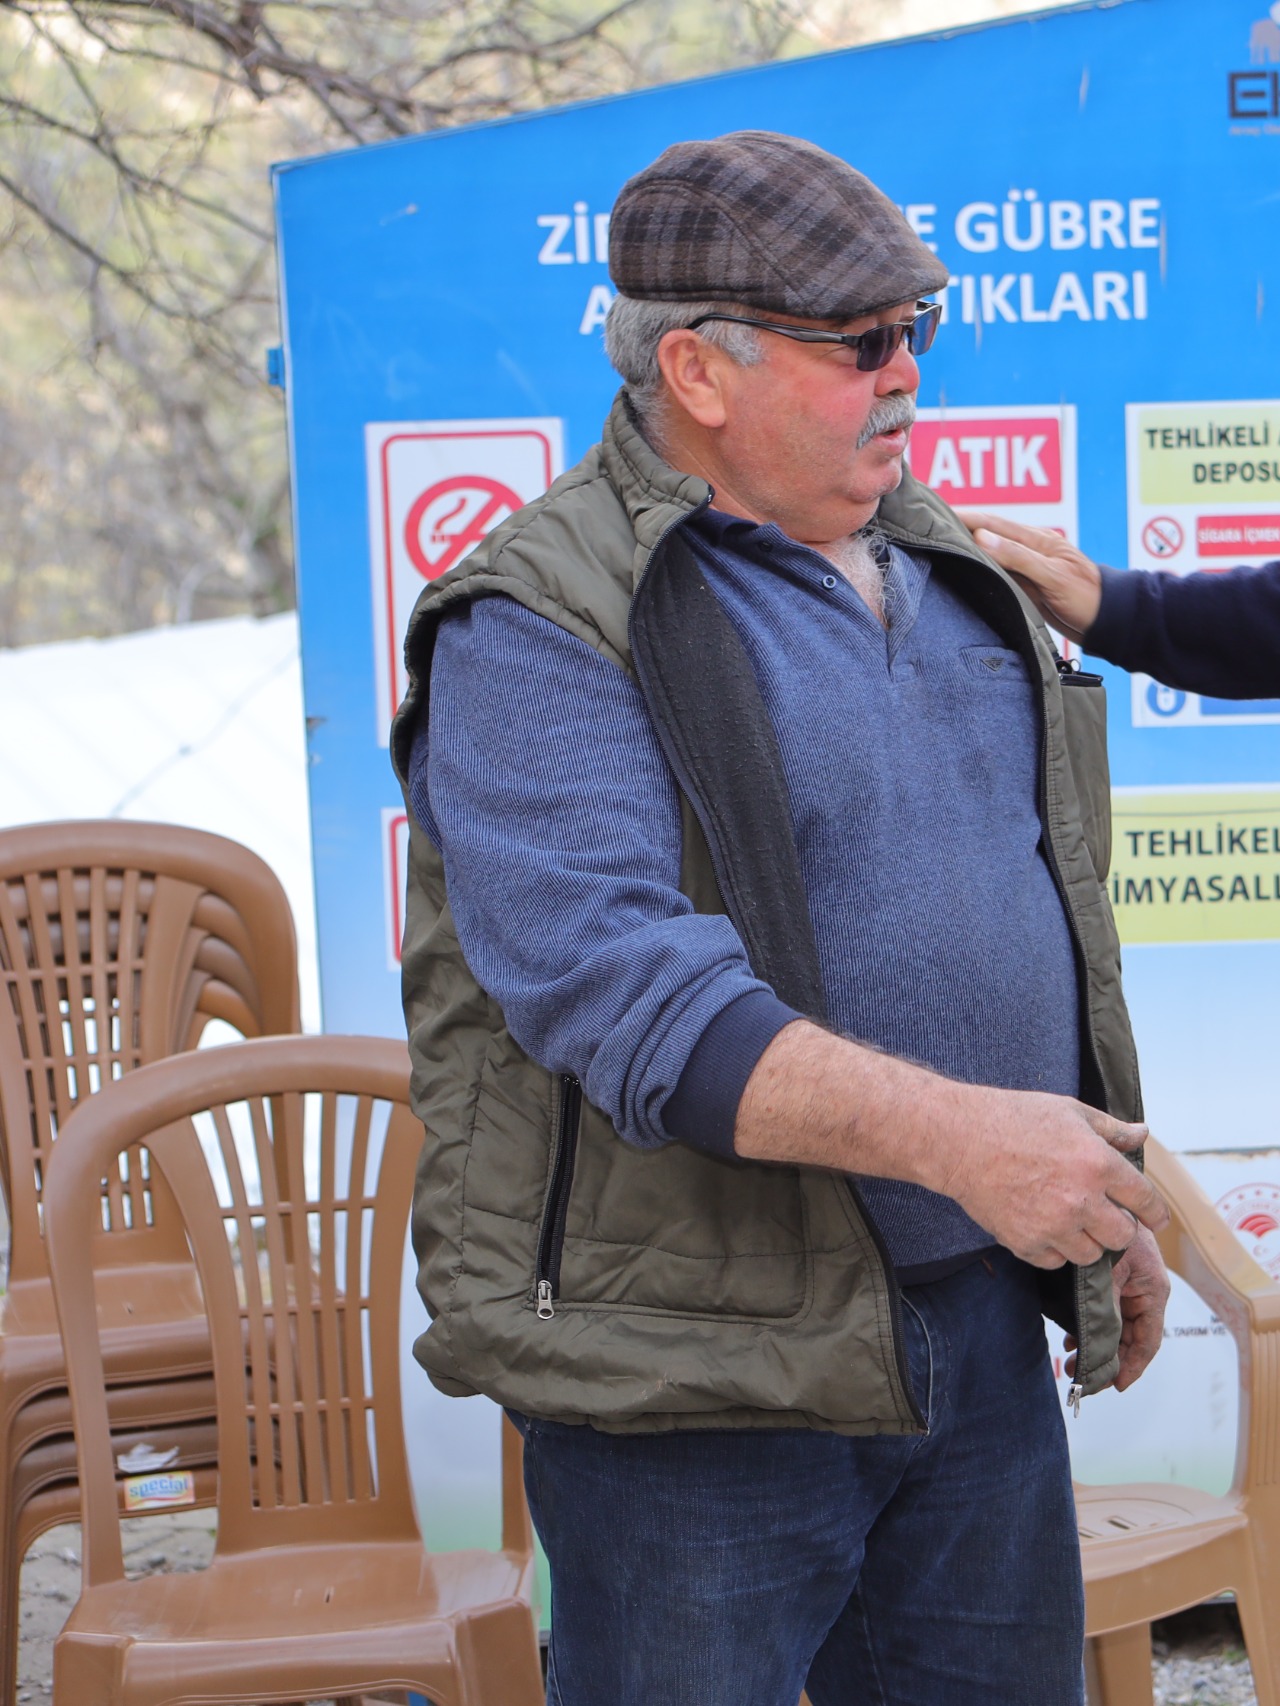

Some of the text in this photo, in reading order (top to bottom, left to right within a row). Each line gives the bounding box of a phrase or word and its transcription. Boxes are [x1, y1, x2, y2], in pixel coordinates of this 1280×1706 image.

[954, 188, 1161, 254] GÜBRE
[934, 270, 1148, 324] TIKLARI
[1145, 420, 1270, 449] TEHLİKELİ
[927, 434, 1050, 490] ATIK
[129, 1474, 189, 1497] special
